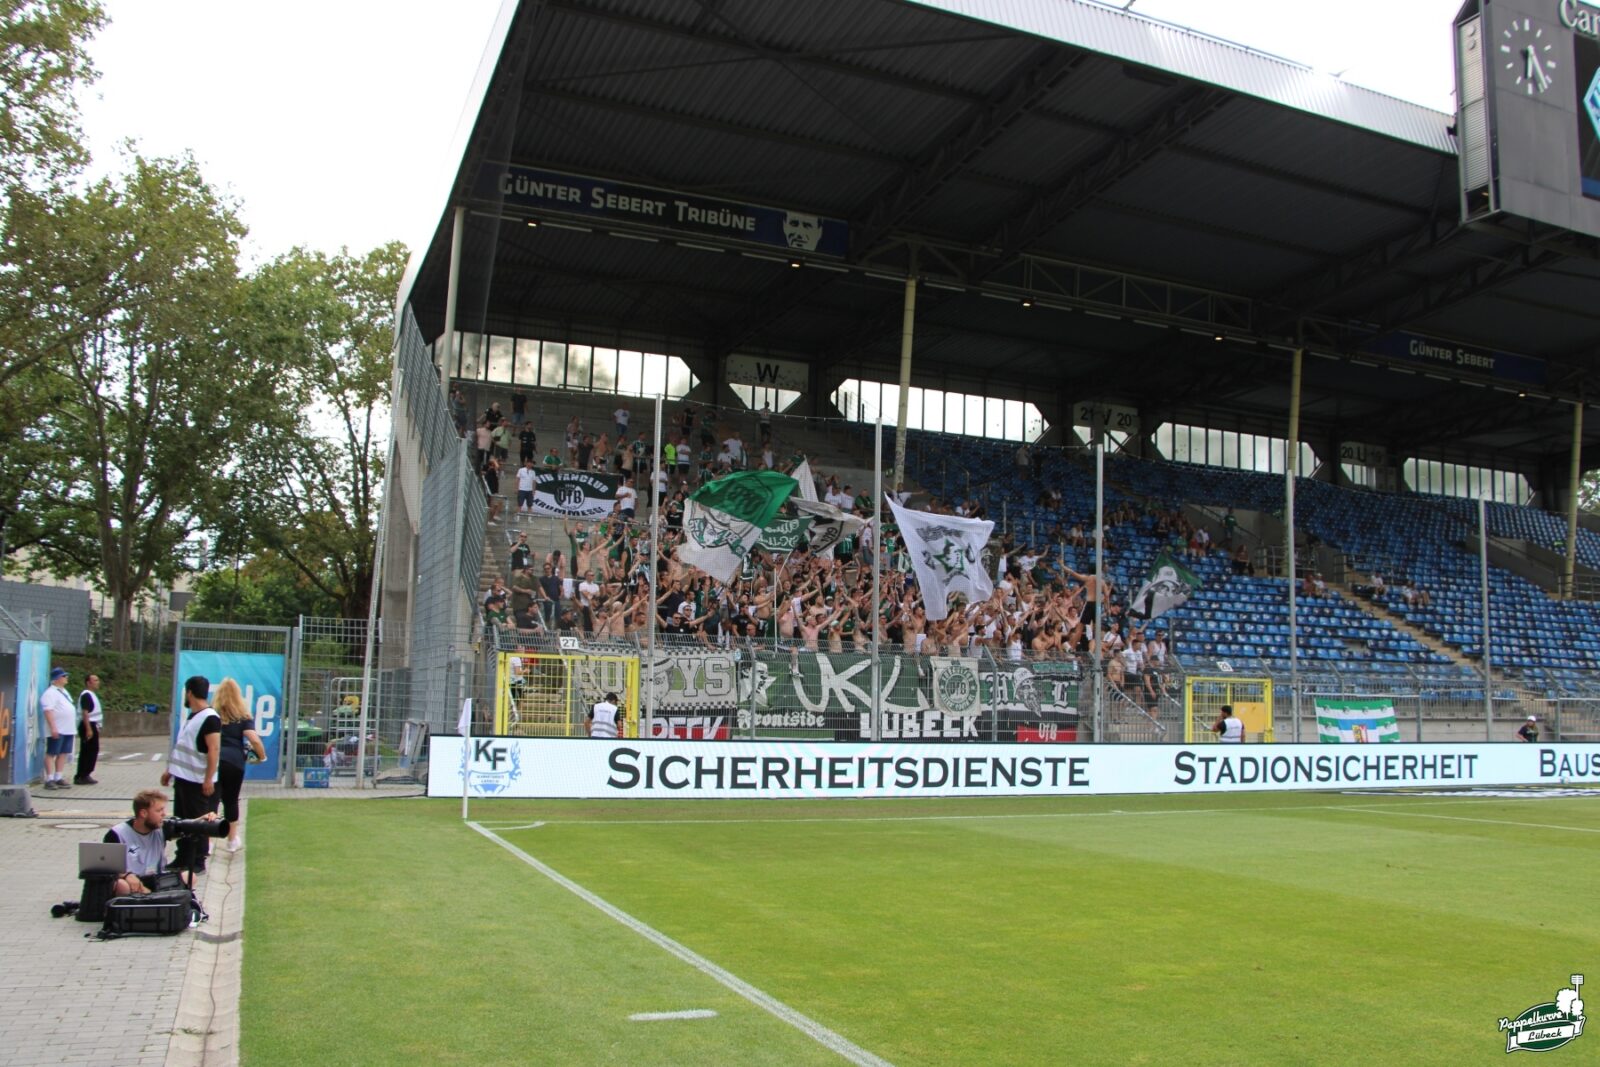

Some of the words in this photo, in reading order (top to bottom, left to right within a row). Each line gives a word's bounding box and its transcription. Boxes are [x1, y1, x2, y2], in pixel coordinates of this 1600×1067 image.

[499, 173, 581, 203] GÜNTER
[591, 187, 667, 216] SEBERT
[674, 201, 757, 231] TRIBÜNE
[1409, 339, 1453, 361] GÜNTER
[1456, 348, 1496, 369] SEBERT
[756, 362, 780, 384] W
[1116, 412, 1132, 427] 20
[557, 473, 609, 493] FANCLUB
[562, 638, 576, 647] 27
[475, 739, 508, 771] KF
[607, 746, 1090, 790] SICHERHEITSDIENSTE
[1174, 751, 1479, 785] STADIONSICHERHEIT
